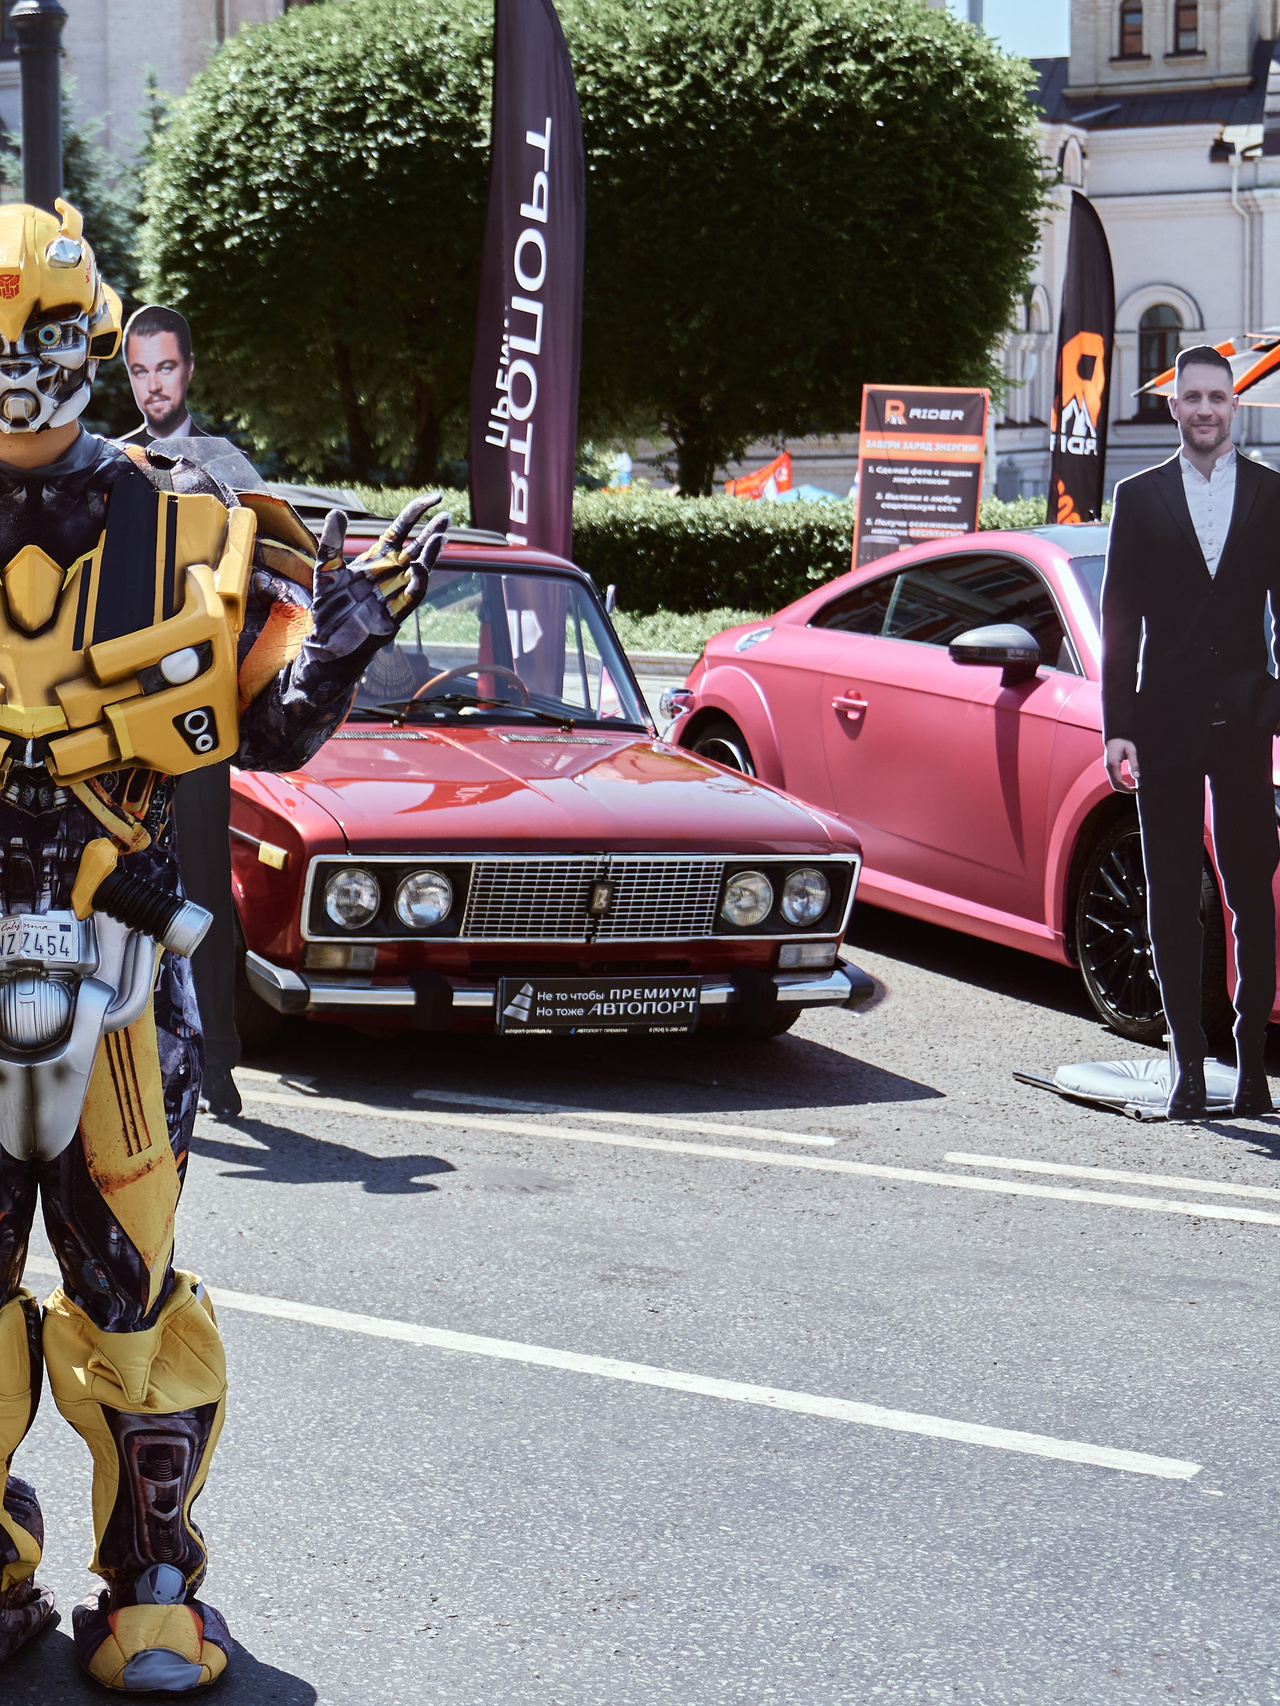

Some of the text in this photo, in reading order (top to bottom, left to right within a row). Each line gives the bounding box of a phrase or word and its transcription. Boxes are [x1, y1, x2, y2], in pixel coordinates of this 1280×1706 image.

[909, 407, 965, 421] RIDER
[866, 439, 901, 450] ЗАБЕРИ
[903, 441, 933, 452] ЗАРЯД
[910, 467, 933, 477] фото
[941, 469, 973, 478] нашим
[930, 495, 962, 505] любую
[880, 502, 958, 513] социальную сеть
[536, 987, 697, 1001] Не то чтобы ПРЕМИУМ
[536, 1000, 697, 1017] Но тоже АВТОПОРТ
